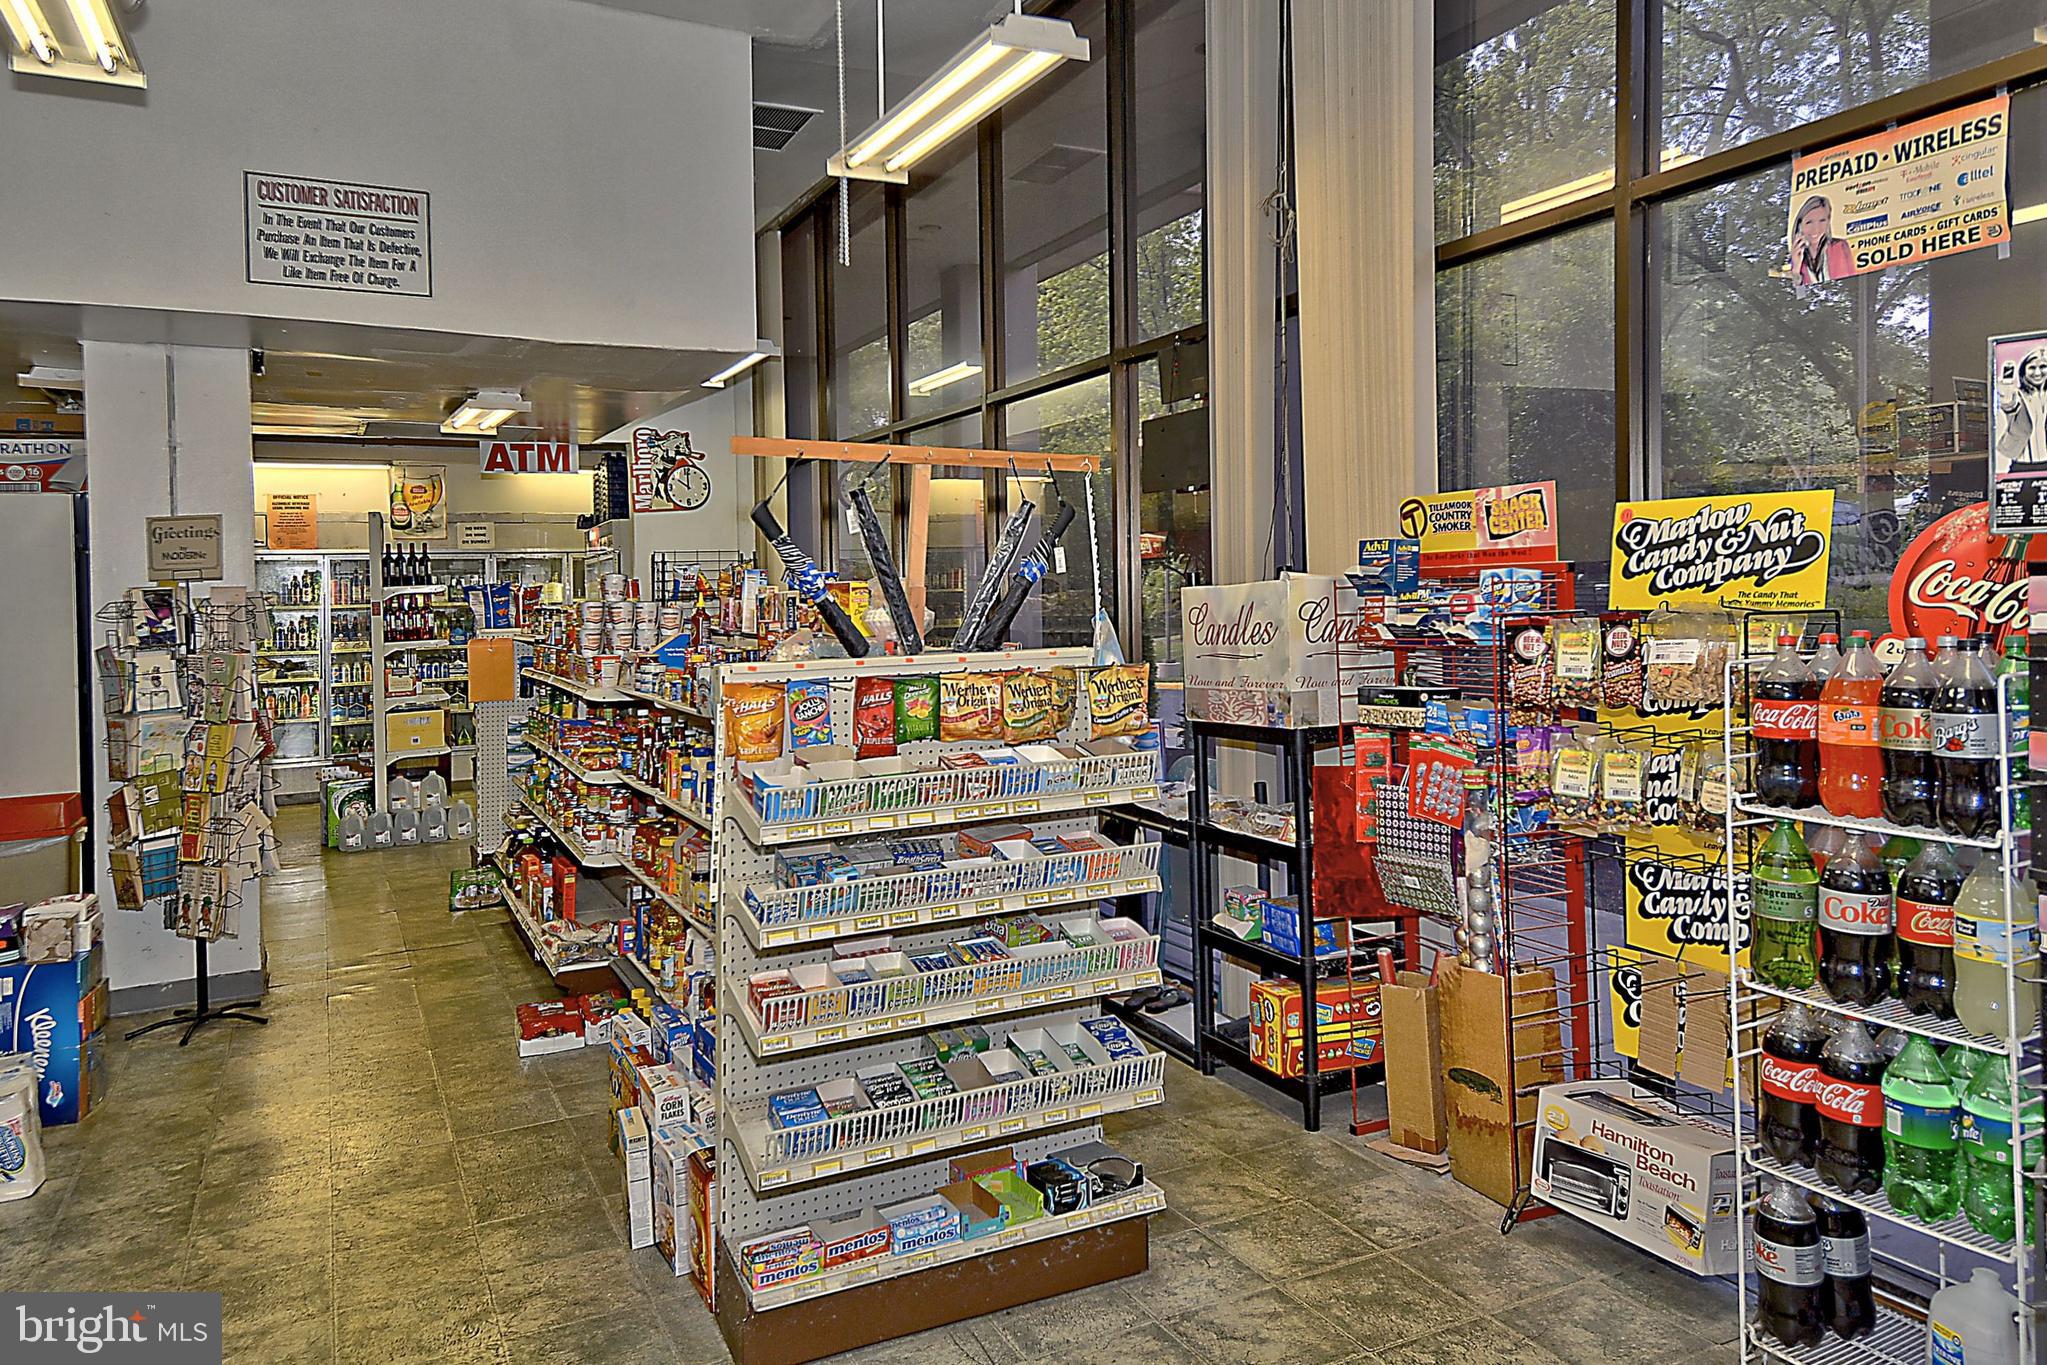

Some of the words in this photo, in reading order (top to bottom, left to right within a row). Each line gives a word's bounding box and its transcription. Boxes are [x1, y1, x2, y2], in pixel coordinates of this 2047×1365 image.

[1795, 151, 1879, 193] PREPAID
[1894, 113, 2002, 166] WIRELESS
[257, 180, 329, 207] CUSTOMER
[334, 188, 419, 216] SATISFACTION
[263, 212, 273, 225] In
[276, 213, 293, 227] The
[297, 216, 322, 231] Event
[325, 219, 346, 233] That
[349, 220, 365, 234] Our
[369, 223, 415, 239] Customers
[1857, 234, 1891, 250] PHONE
[1894, 224, 1927, 241] CARDS
[1936, 217, 1959, 232] GIFT
[1963, 207, 1999, 226] CARDS
[257, 229, 299, 244] Purchase
[303, 234, 316, 246] An
[320, 235, 341, 249] Item
[344, 237, 363, 251] That
[368, 240, 376, 251] Is
[1856, 243, 1914, 269] SOLD
[1921, 225, 1982, 255] HERE
[263, 246, 279, 260] We
[281, 247, 299, 262] Will
[303, 250, 345, 267] Exchange
[349, 254, 365, 268] The
[369, 256, 388, 270] Item
[392, 259, 406, 271] For
[409, 261, 417, 272] A
[282, 265, 302, 279] Like
[305, 267, 326, 281] Item
[330, 270, 349, 284] Free
[352, 272, 364, 285] Of
[367, 273, 400, 289] Charge.
[484, 443, 570, 472] ATM
[634, 429, 651, 510] Marlboro
[1429, 501, 1472, 513] TILLAMOOK
[1491, 494, 1541, 514] SNACK
[1429, 511, 1472, 523] COUNTRY
[1489, 511, 1545, 535] CENTER
[152, 526, 221, 544] Greetings
[1432, 522, 1471, 533] SMOKER
[1622, 503, 1751, 550] Marlow
[1365, 541, 1389, 552] Advil
[1629, 535, 1714, 573] Candy
[1715, 529, 1746, 554] &
[1745, 509, 1805, 547] Nut
[1656, 531, 1824, 590] Company
[1738, 591, 1752, 599] The
[1754, 591, 1777, 599] Candy
[1780, 591, 1799, 599] That
[1189, 602, 1279, 646] Candles
[1523, 636, 1541, 644] BEER
[1611, 639, 1628, 649] NUTS
[1612, 632, 1628, 640] BEER
[1090, 676, 1145, 694] Werther's
[1188, 675, 1213, 686] Now
[1215, 677, 1234, 687] and
[1296, 675, 1329, 688] Now
[1332, 674, 1351, 686] and
[862, 691, 893, 705] HALLS
[943, 682, 999, 698] Werther's
[797, 698, 820, 712] JOLLY
[1427, 706, 1437, 718] 24
[1753, 703, 1818, 729] Coca-Cola
[1833, 710, 1860, 722] Fanta
[1880, 714, 1932, 740] Cok
[1561, 767, 1587, 775] Mountain
[1755, 884, 1804, 899] Seagram's
[1645, 891, 1727, 921] Candy
[1825, 897, 1888, 924] Coke
[1916, 905, 1948, 913] CAFFEINE
[985, 920, 1006, 936] extra
[907, 1059, 936, 1069] Dentyne
[871, 1080, 902, 1092] Dentyne
[924, 1085, 953, 1095] Dentyne
[776, 1090, 812, 1101] Dentyne
[881, 1096, 912, 1108] Dentyne
[660, 1100, 683, 1112] CORN
[661, 1109, 685, 1120] FLAKES
[786, 1109, 821, 1121] Dentyne
[4, 1129, 24, 1162] NAPKINS
[1592, 1119, 1674, 1166] Hamilton
[1637, 1156, 1696, 1193] Beach
[1638, 1175, 1681, 1202] Toastation
[770, 1238, 810, 1249] mentos
[828, 1231, 887, 1257] mentos
[902, 1227, 955, 1250] mentos
[757, 1246, 797, 1262] mentos
[760, 1262, 818, 1285] mentos
